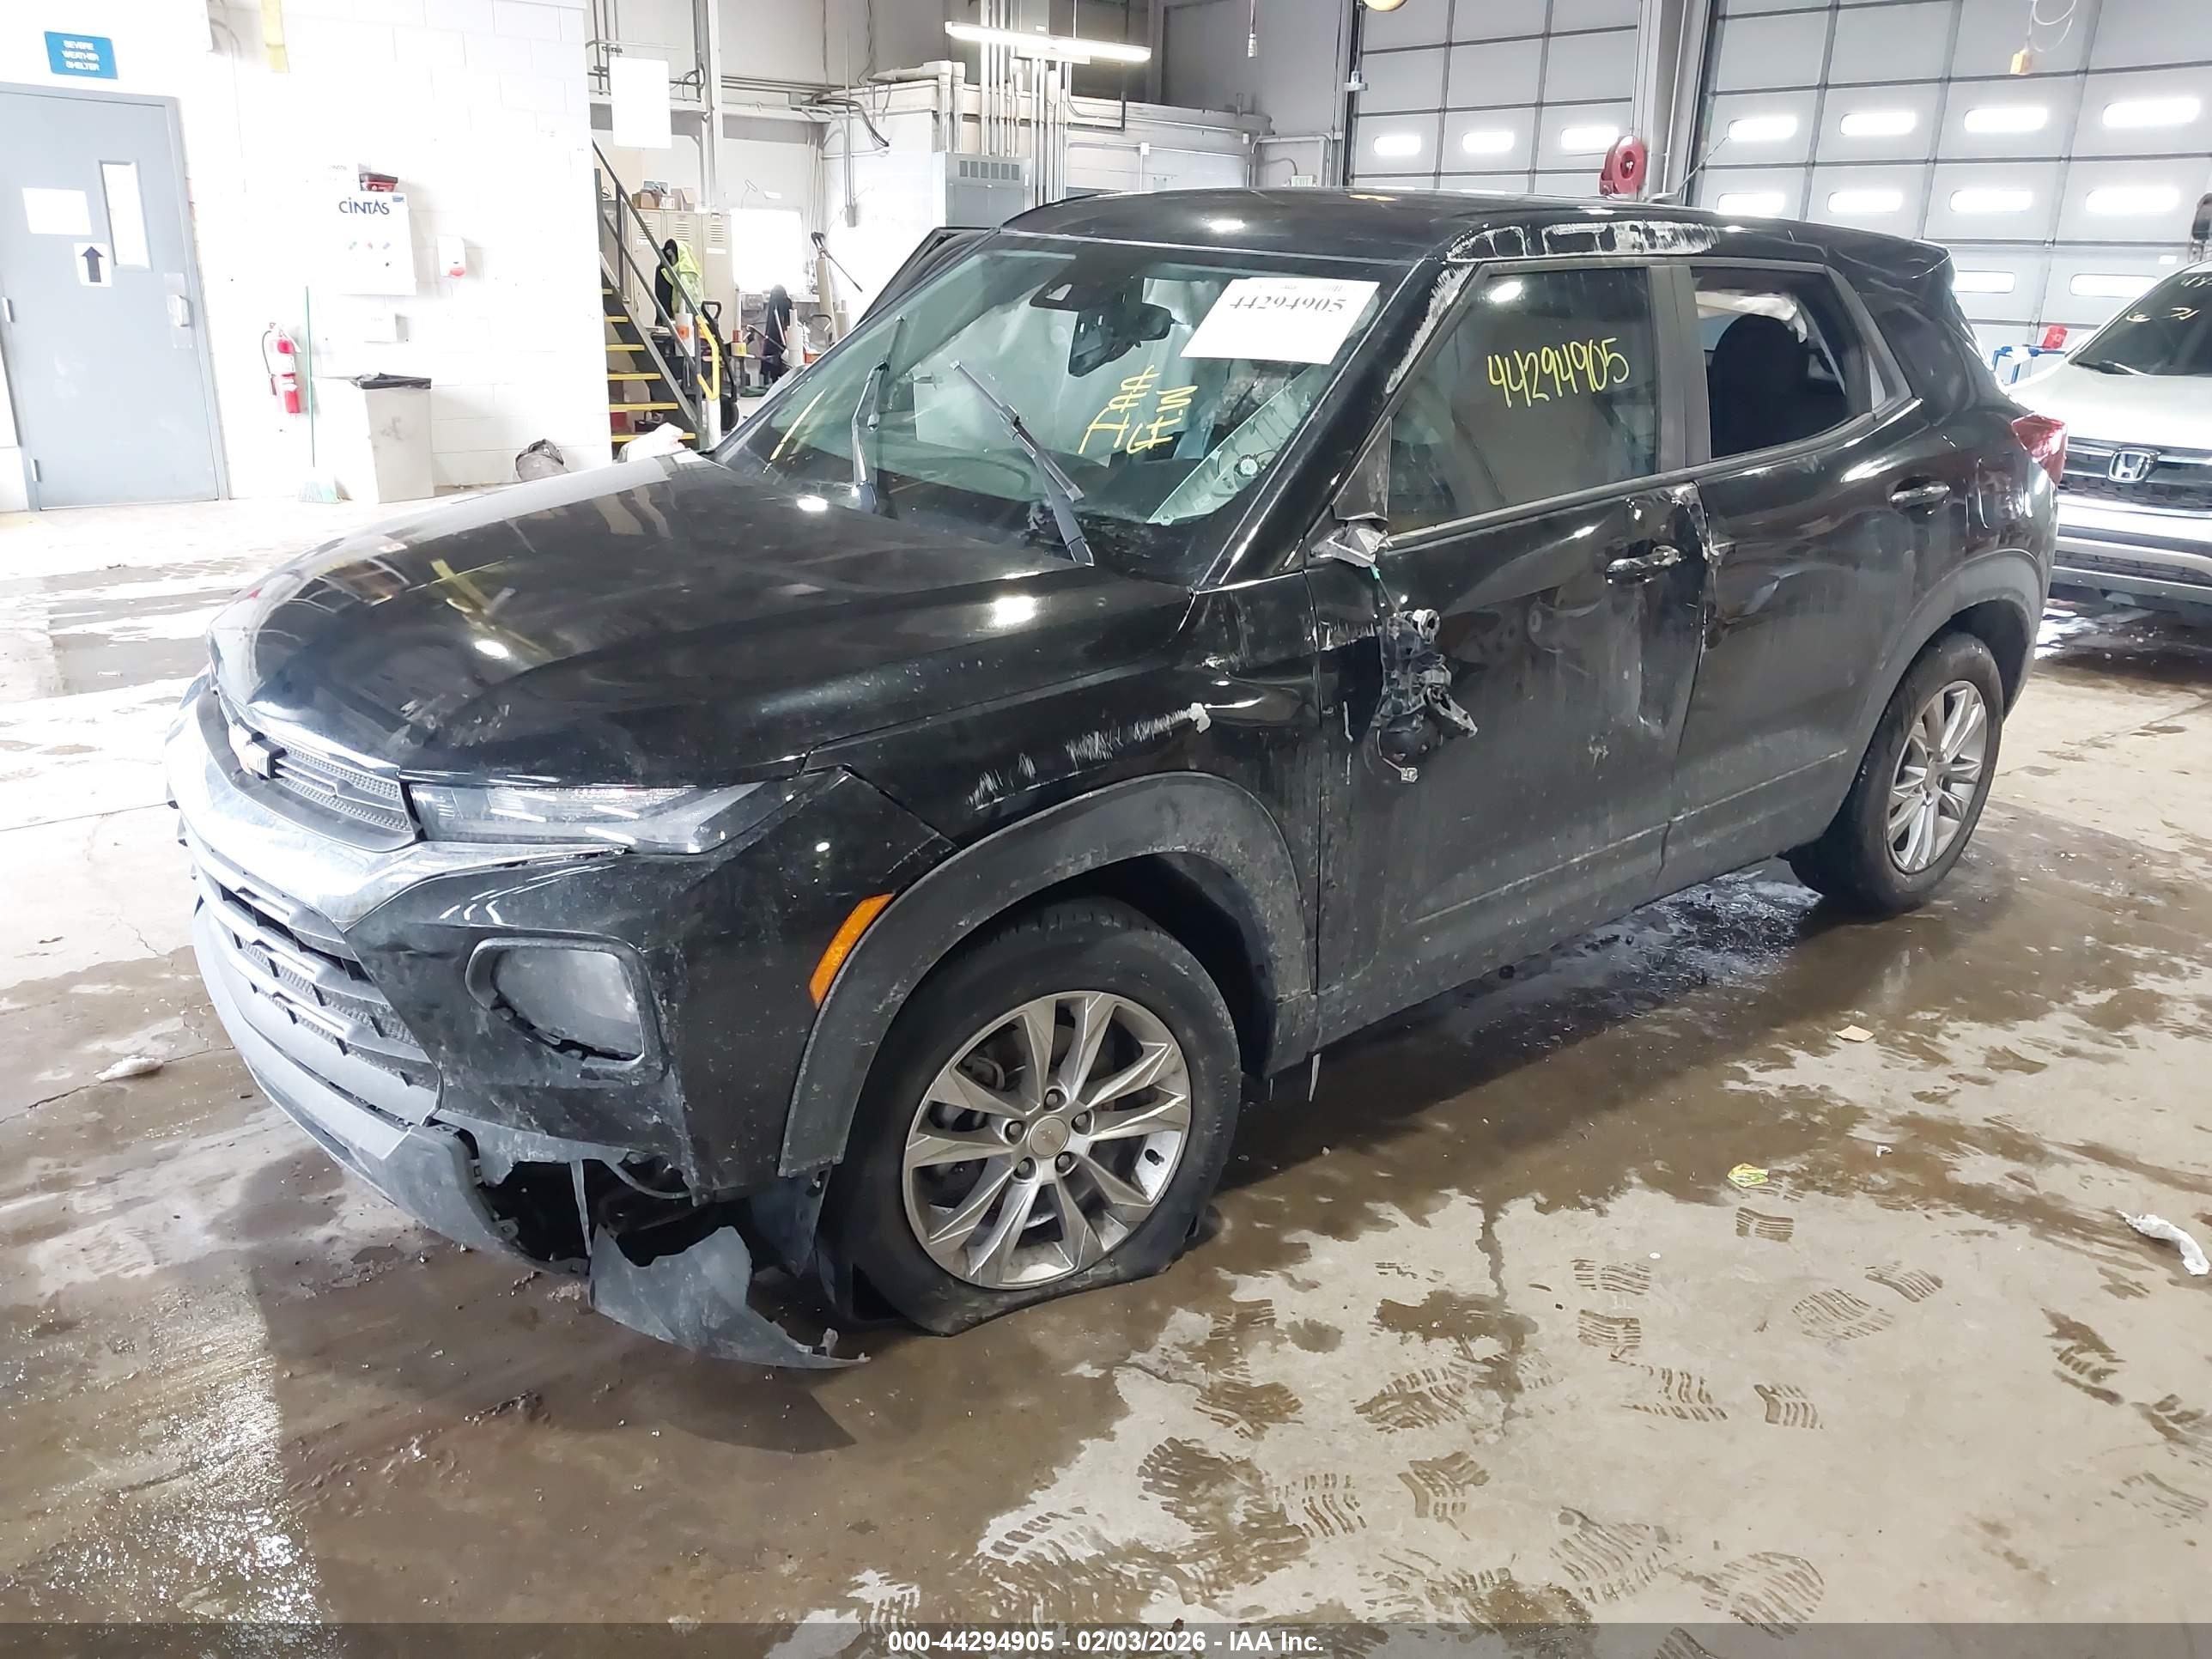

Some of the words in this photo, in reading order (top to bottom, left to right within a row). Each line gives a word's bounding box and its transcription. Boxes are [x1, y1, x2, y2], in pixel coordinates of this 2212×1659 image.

[61, 50, 100, 61] WEATHER
[65, 60, 100, 71] SHELTER
[1230, 295, 1347, 313] 44294905
[1487, 337, 1630, 408] 44294905
